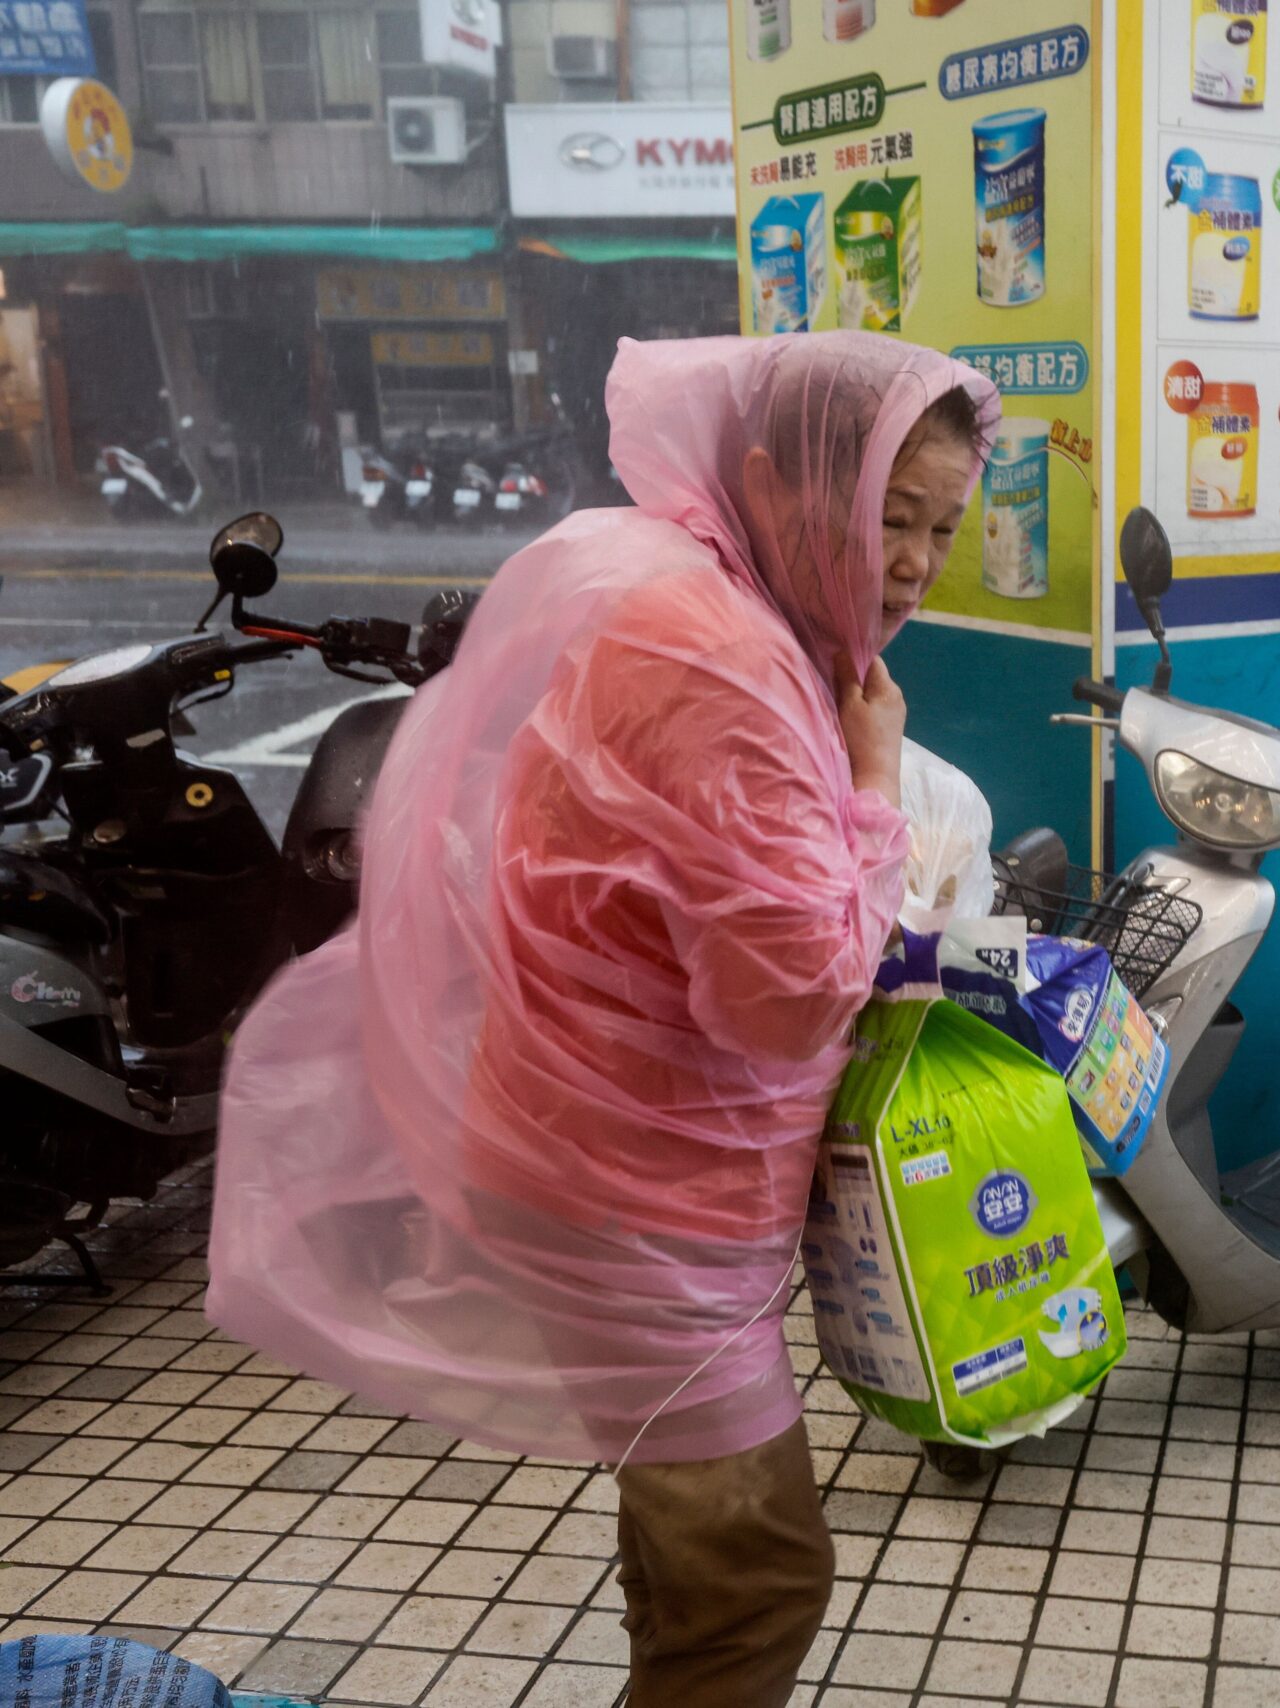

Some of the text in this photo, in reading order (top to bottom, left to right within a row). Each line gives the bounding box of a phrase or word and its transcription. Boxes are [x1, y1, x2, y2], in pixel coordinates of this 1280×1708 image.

[946, 34, 1079, 93] 糖尿病均衡配方
[780, 85, 877, 136] 腎臟適用配方
[635, 138, 735, 167] KYM
[957, 351, 1079, 387] 鉻均衡配方
[964, 1232, 1071, 1298] 頂級淨爽
